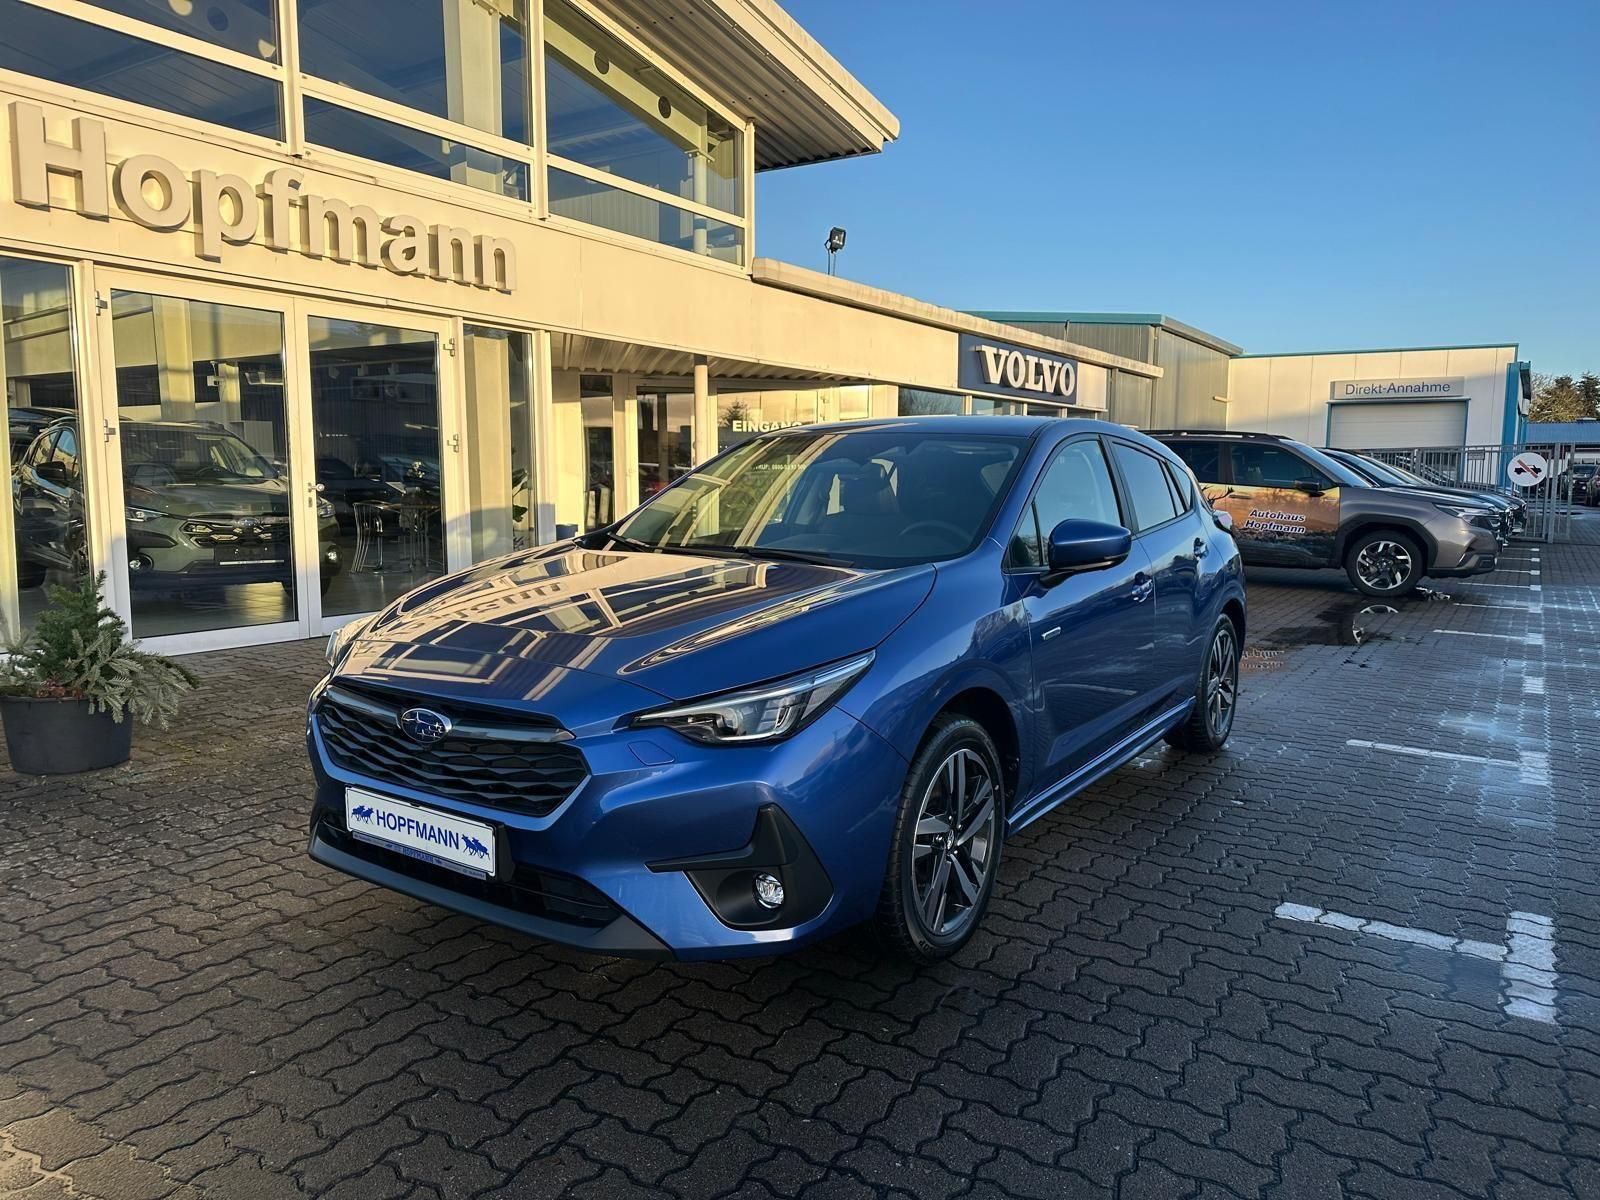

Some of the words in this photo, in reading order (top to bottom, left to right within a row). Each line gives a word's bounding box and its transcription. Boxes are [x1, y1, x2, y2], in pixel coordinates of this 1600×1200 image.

[9, 100, 518, 296] Hopfmann
[976, 344, 1076, 397] VOLVO
[1345, 381, 1451, 396] Direkt-Annahme
[1245, 519, 1306, 534] Hopfmann
[1249, 509, 1306, 522] Autohaus
[376, 809, 459, 850] HOPFMANN
